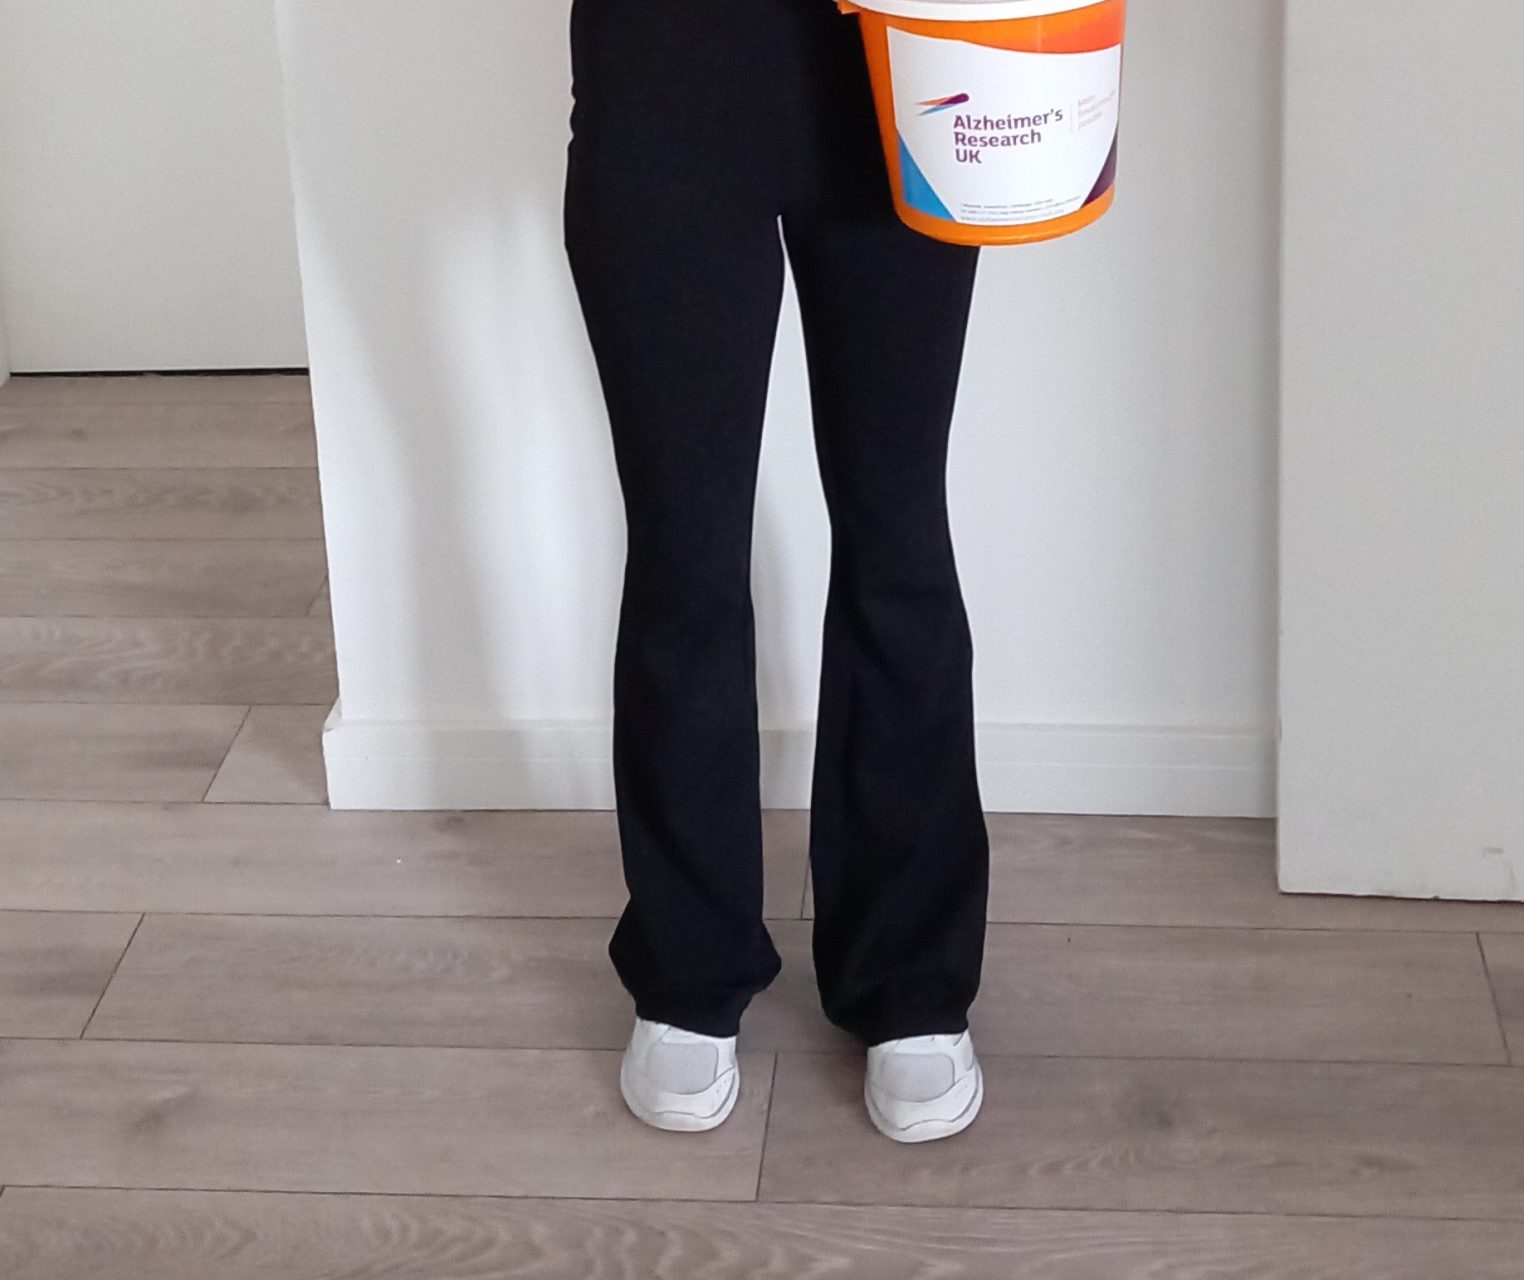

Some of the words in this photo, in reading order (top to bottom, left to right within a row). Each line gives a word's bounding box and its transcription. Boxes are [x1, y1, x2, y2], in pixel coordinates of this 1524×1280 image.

[953, 108, 1064, 131] Alzheimer's
[954, 129, 1042, 147] Research
[955, 148, 982, 164] UK
